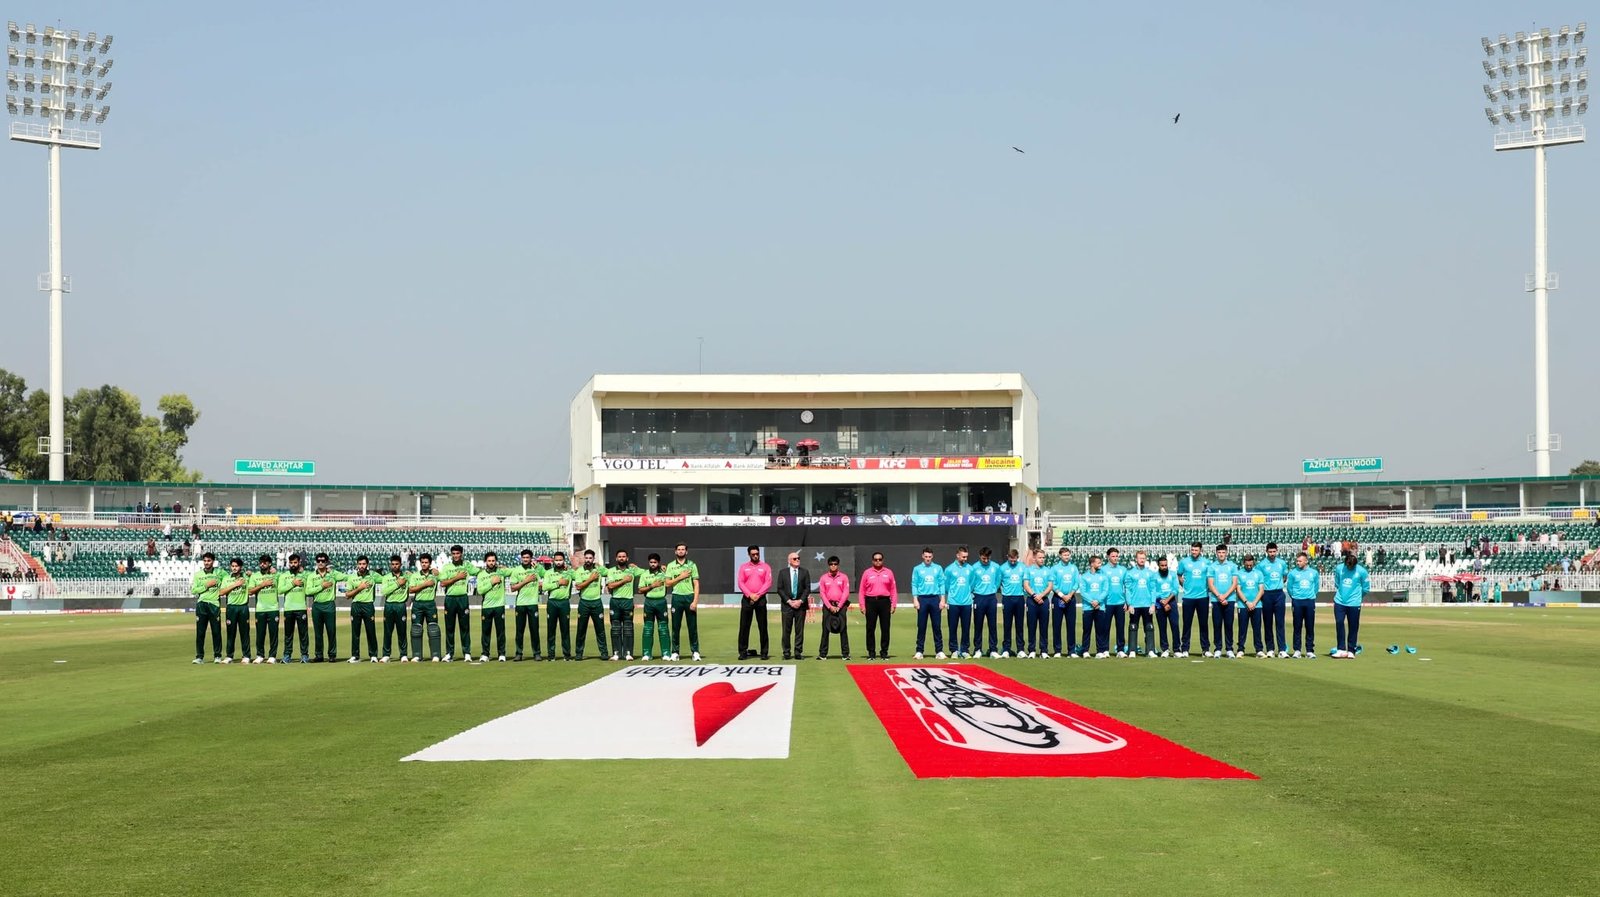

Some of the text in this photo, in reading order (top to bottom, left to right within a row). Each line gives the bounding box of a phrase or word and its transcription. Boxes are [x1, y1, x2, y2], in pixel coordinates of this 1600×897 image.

[247, 461, 304, 469] JAVED AKHTAR
[604, 459, 666, 470] VGO TEL
[879, 459, 907, 469] KFC
[1309, 461, 1335, 469] AZHAR
[1337, 459, 1376, 467] MAHMOOD
[796, 516, 830, 525] PEPSI
[626, 666, 783, 677] Bank Alfalah
